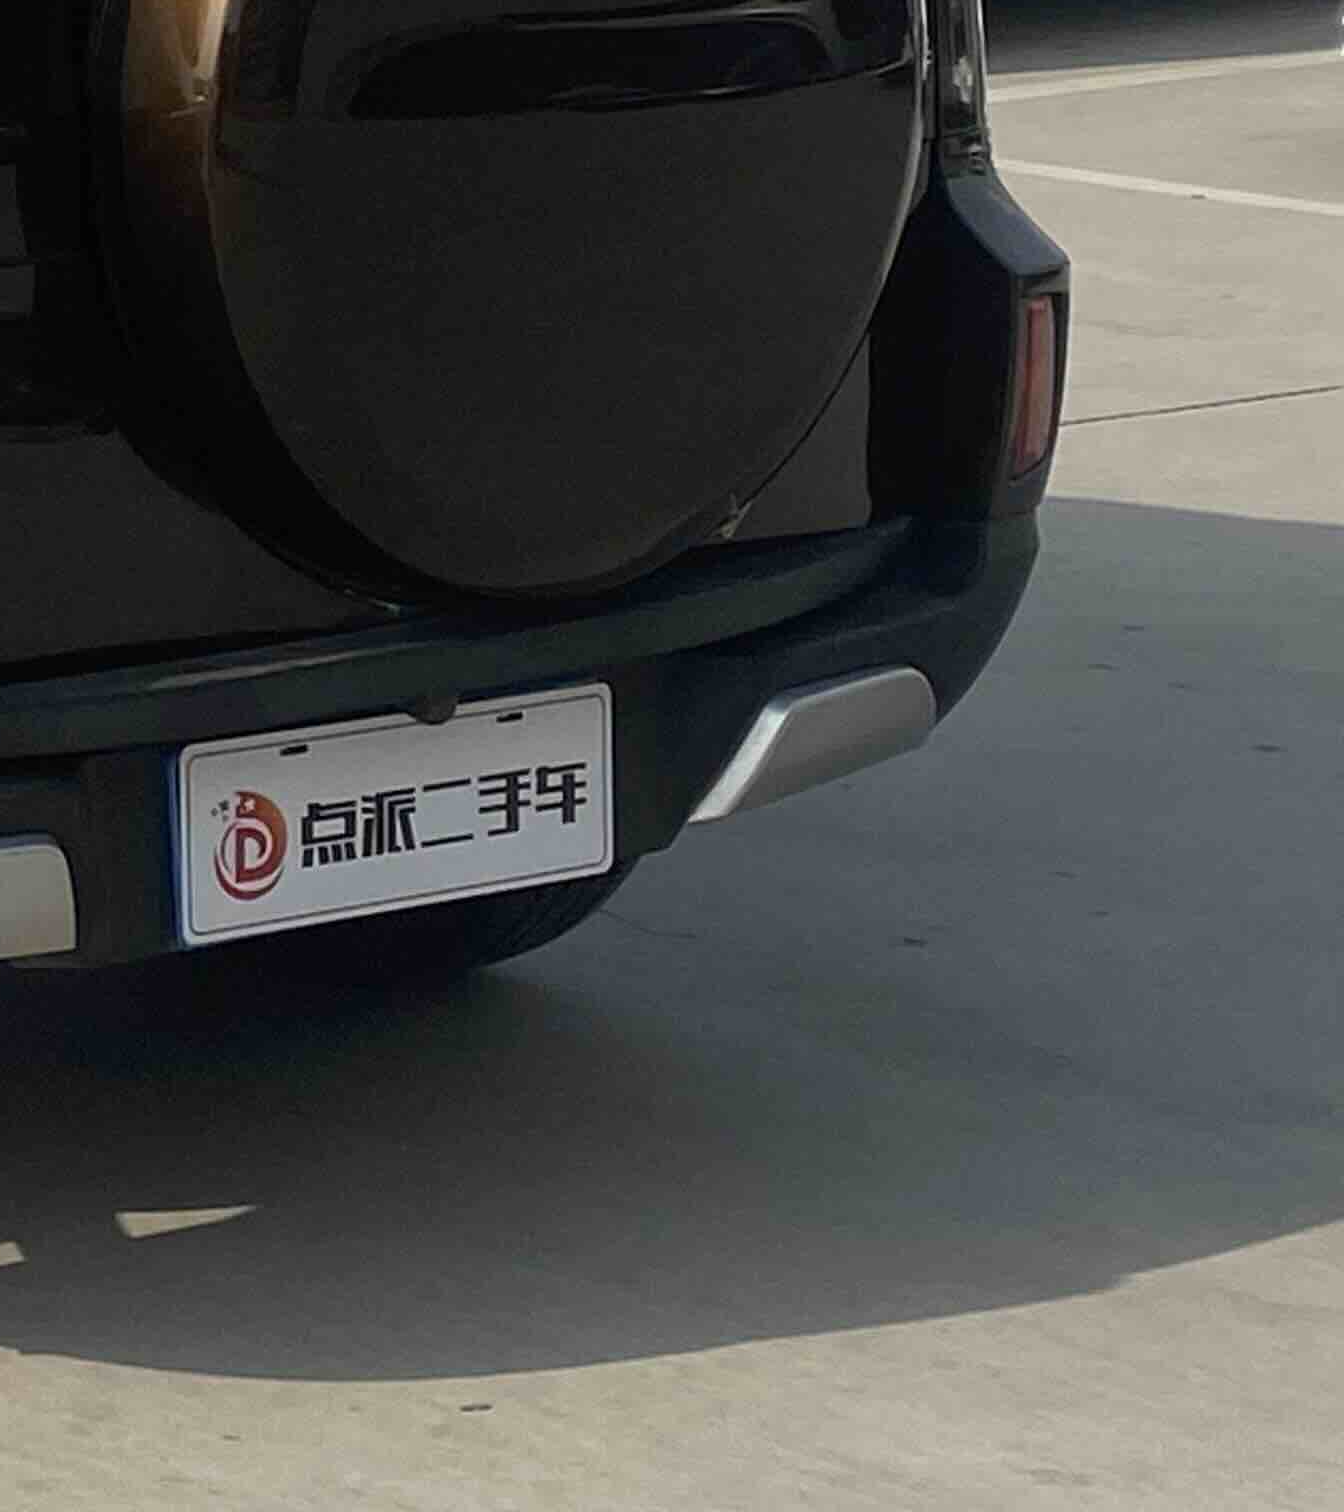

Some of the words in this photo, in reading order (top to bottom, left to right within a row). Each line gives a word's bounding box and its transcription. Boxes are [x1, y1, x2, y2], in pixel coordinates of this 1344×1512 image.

[300, 760, 588, 870] 点派二手车
